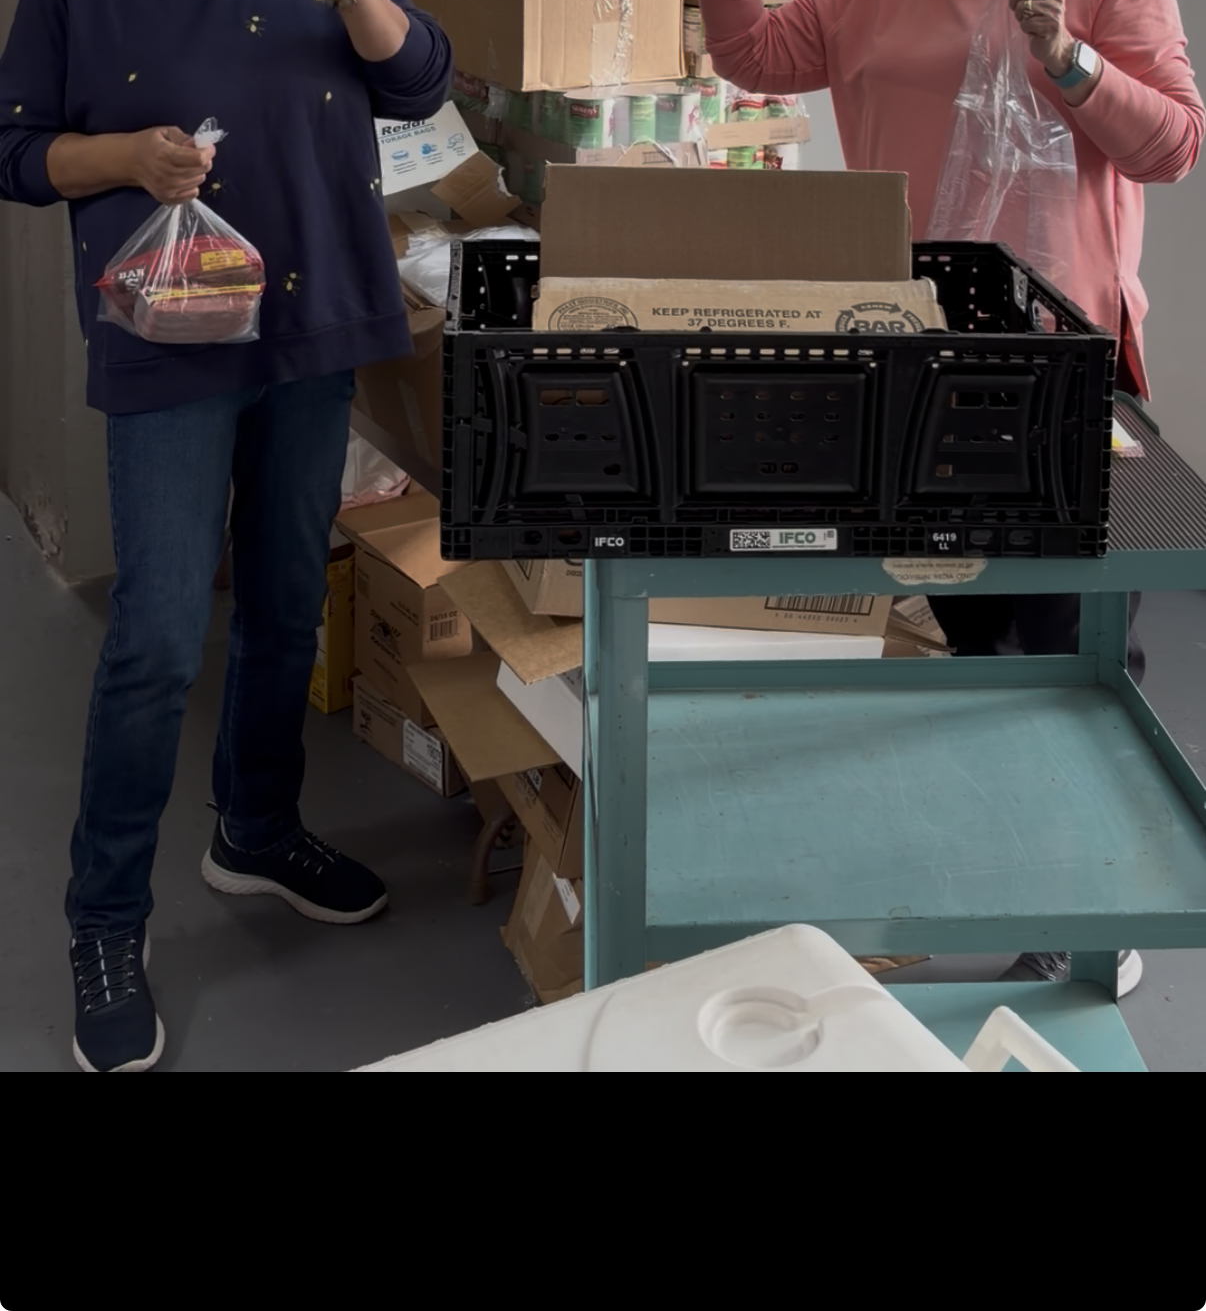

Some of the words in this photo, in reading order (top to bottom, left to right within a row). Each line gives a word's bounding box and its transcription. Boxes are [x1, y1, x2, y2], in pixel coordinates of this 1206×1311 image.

[380, 132, 412, 144] TORAGE
[414, 126, 436, 136] BAGS
[652, 307, 690, 318] KEEP
[693, 308, 802, 319] REFRIGERATED
[804, 309, 822, 319] AT
[687, 318, 704, 327] 37
[707, 318, 775, 329] DEGREES
[594, 537, 625, 548] IFCO
[779, 531, 816, 545] IFCO
[932, 532, 957, 542] 6419
[938, 542, 950, 550] LL
